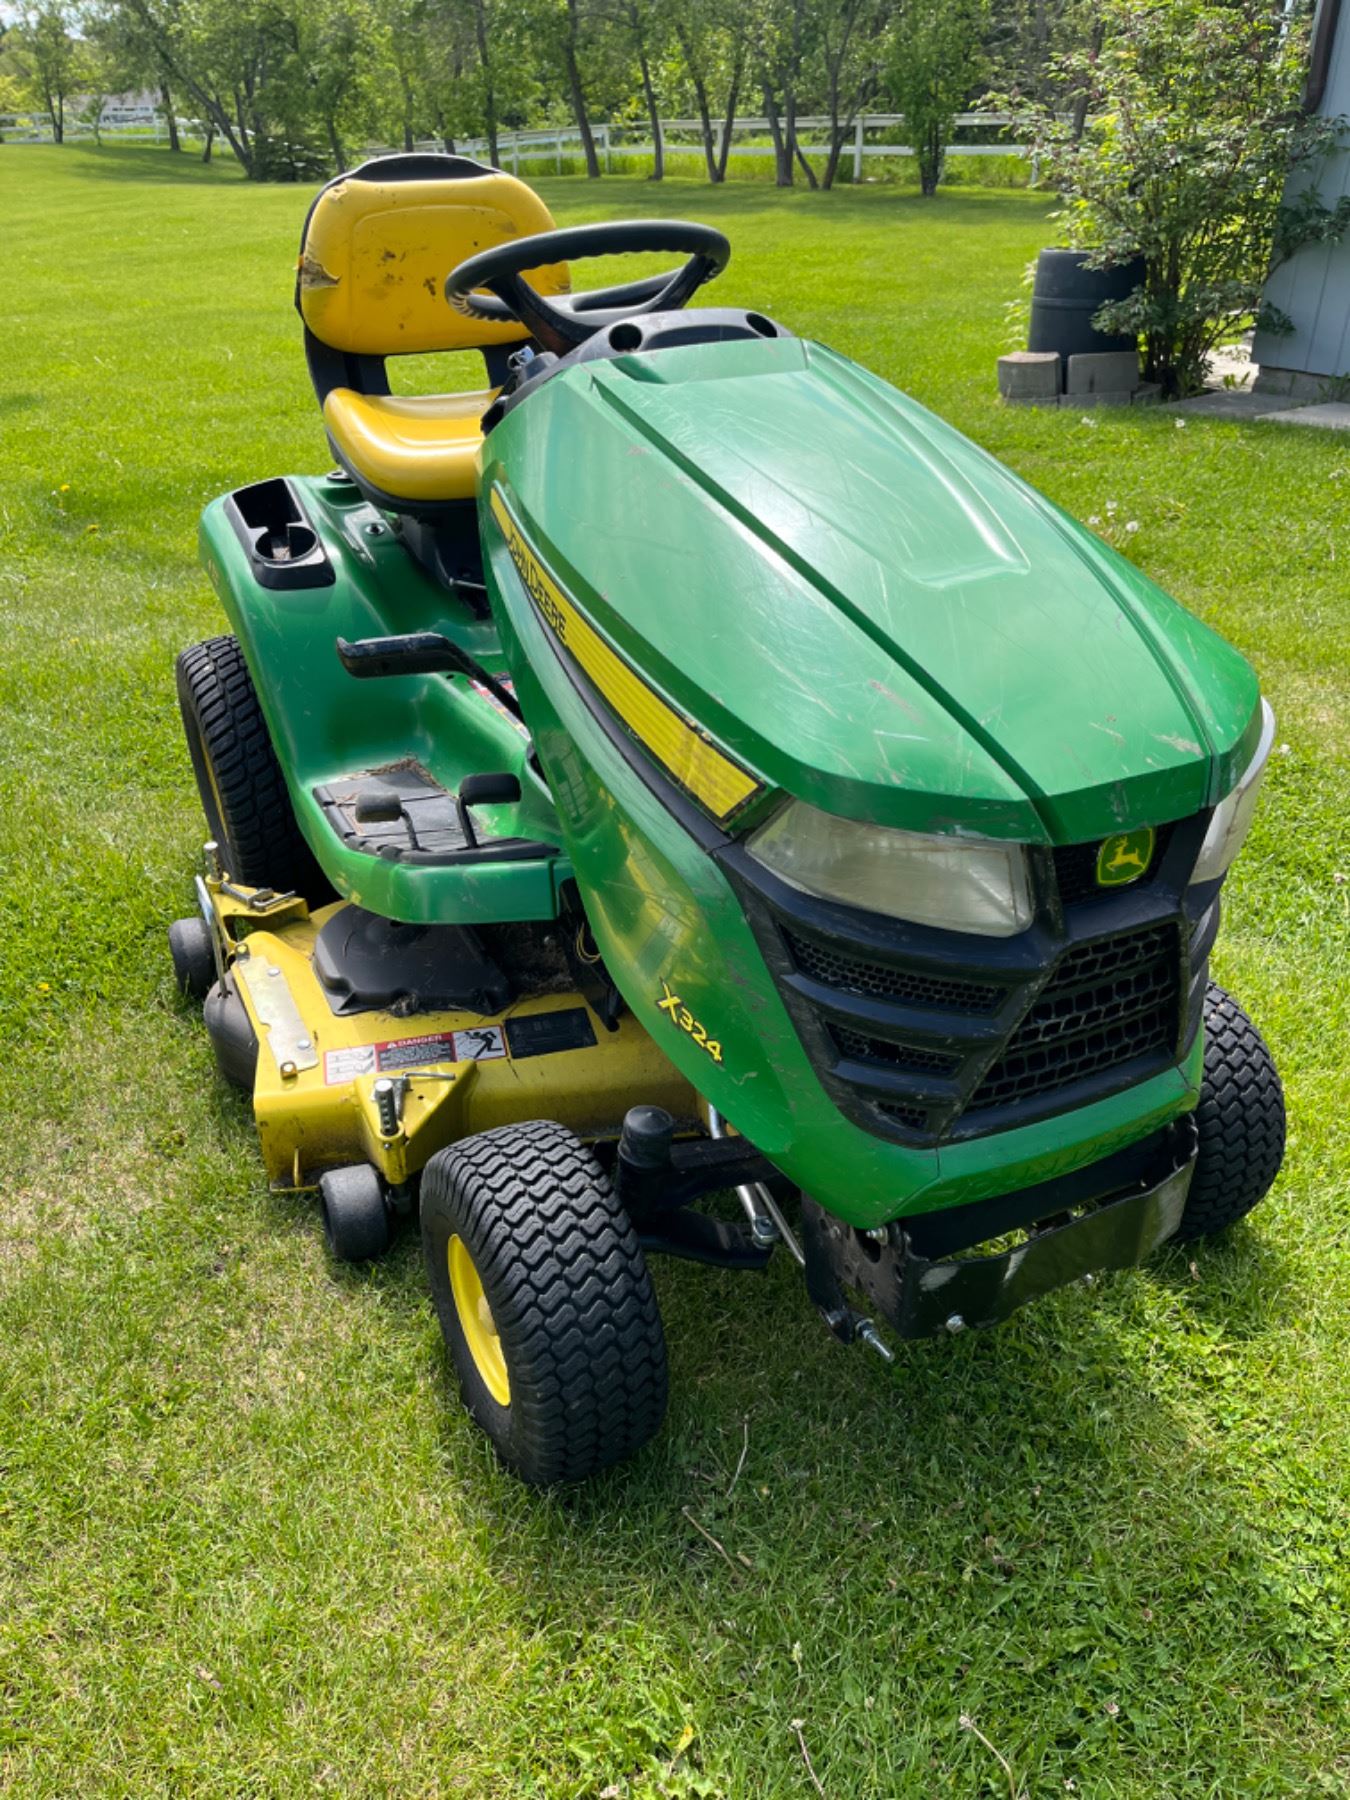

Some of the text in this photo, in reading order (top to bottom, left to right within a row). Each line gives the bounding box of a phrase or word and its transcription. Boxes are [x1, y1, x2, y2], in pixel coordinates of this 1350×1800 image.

[529, 561, 566, 643] DEERE
[397, 1034, 442, 1047] DANGER
[657, 979, 723, 1062] X324
